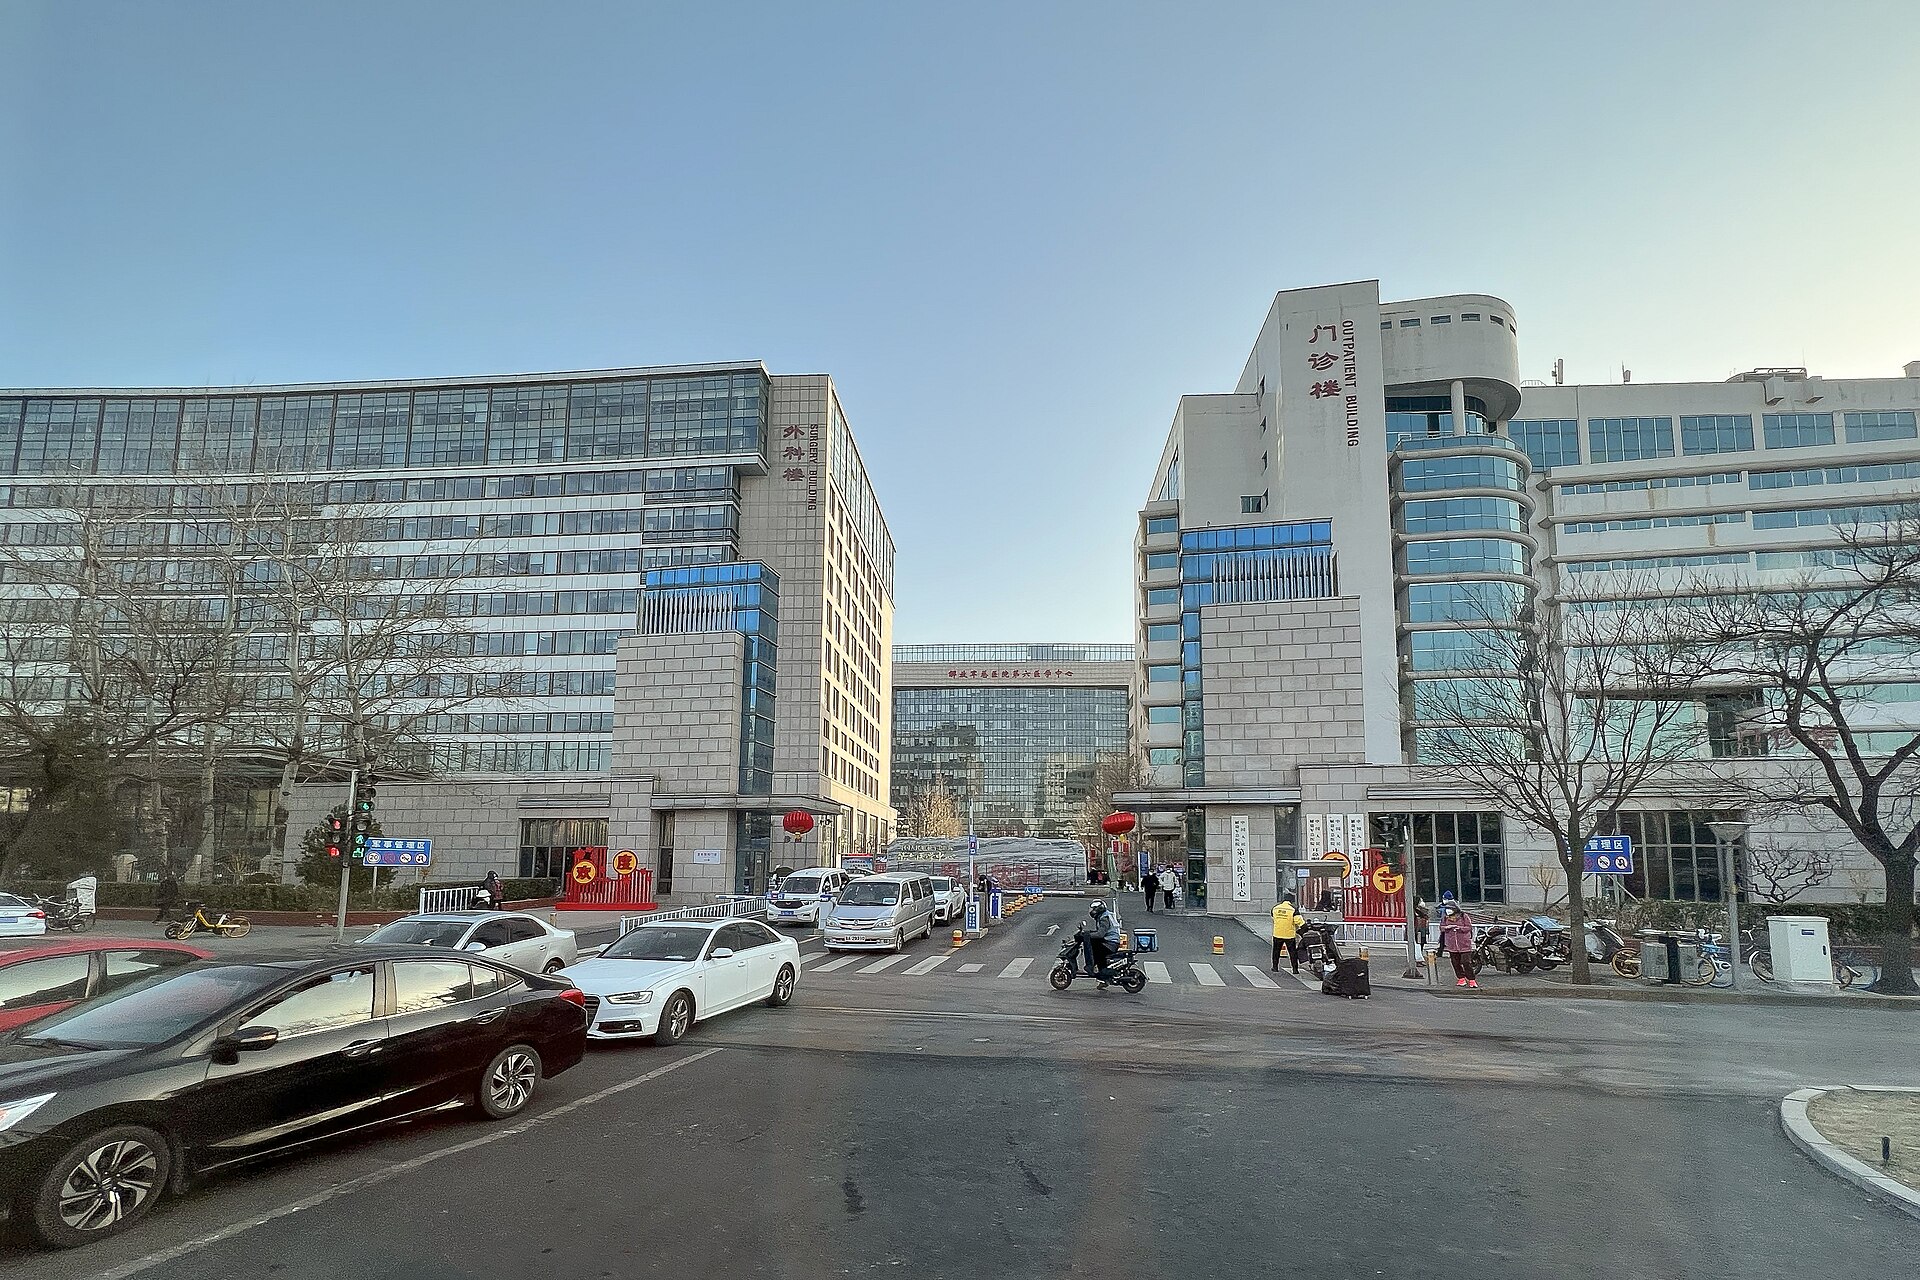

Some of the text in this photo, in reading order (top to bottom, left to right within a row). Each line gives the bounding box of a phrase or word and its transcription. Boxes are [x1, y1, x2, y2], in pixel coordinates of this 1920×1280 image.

[1308, 324, 1342, 399] 门诊楼
[1342, 320, 1359, 447] OUTPATIENT BUILDING
[783, 425, 805, 481] 外科楼
[808, 424, 818, 510] SURGERY BUILDING
[1584, 840, 1623, 850] 管理区
